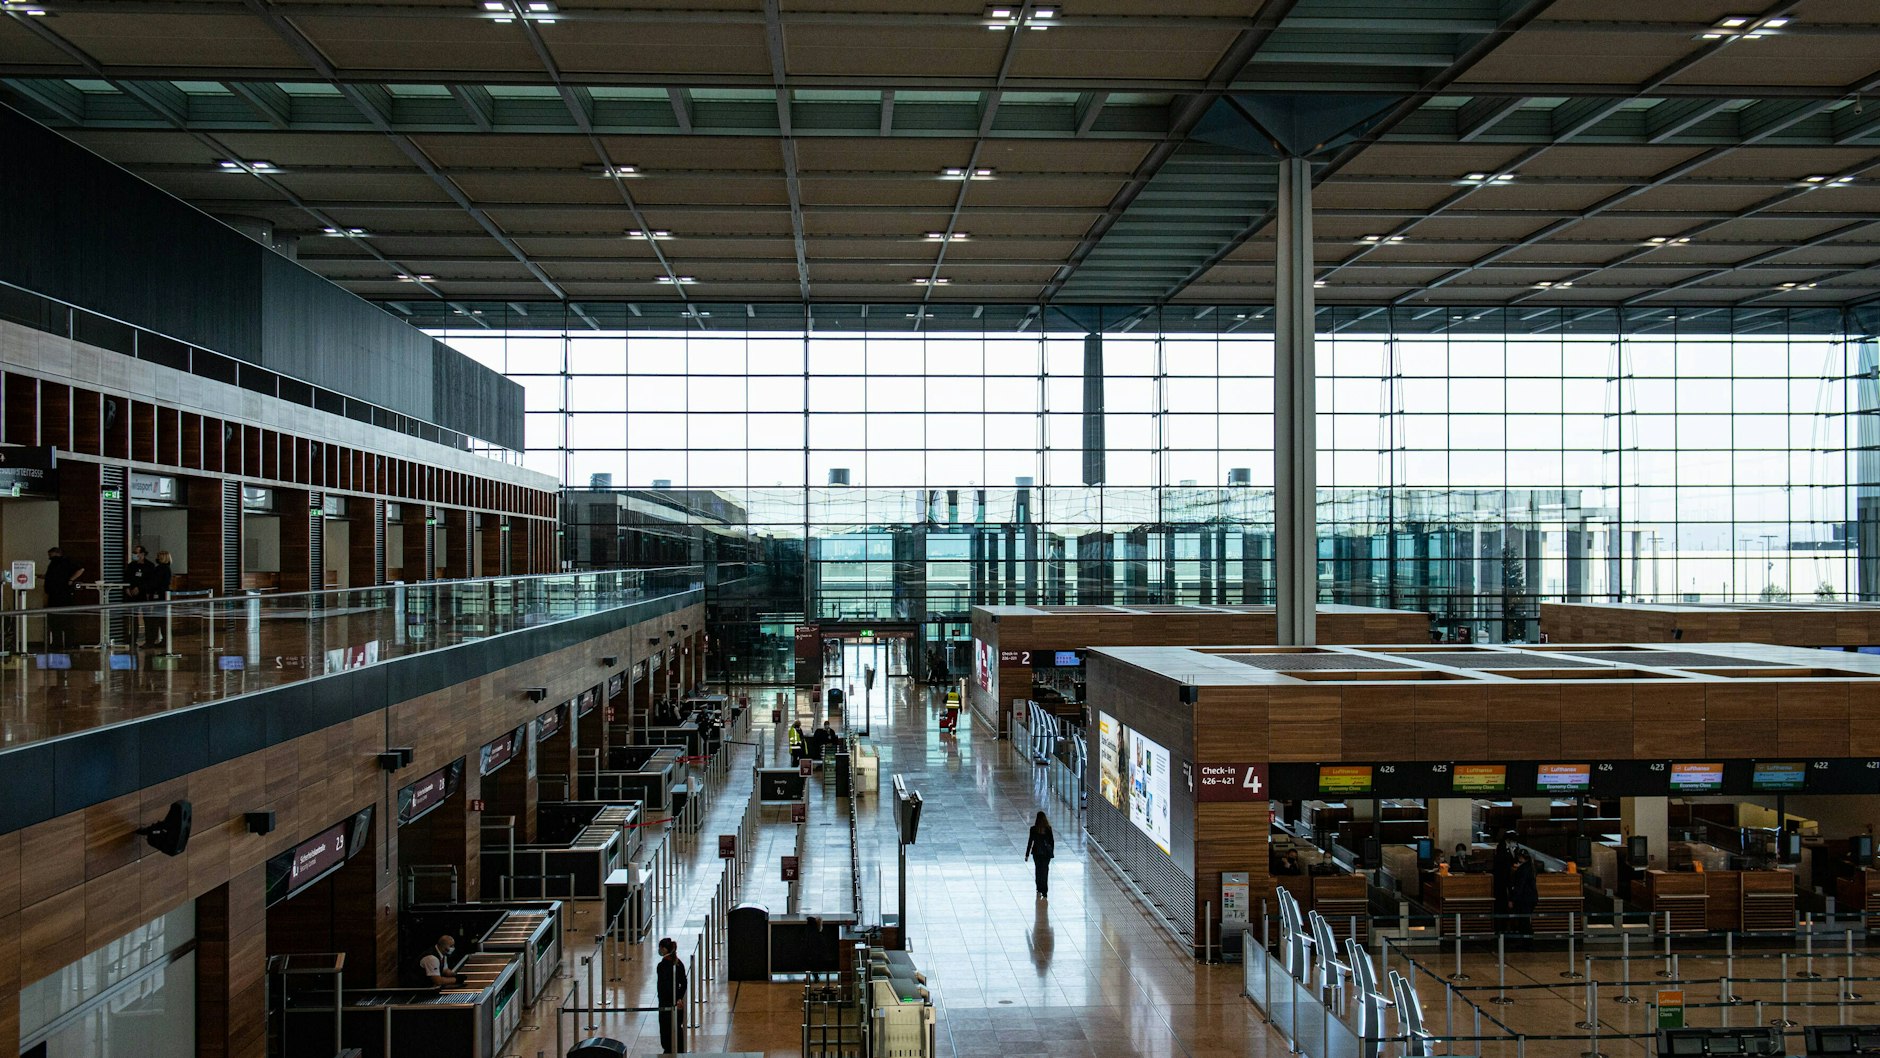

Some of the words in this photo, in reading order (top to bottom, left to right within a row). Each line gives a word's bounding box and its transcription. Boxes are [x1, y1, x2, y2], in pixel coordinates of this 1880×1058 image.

[1021, 651, 1030, 665] 2
[1380, 765, 1395, 773] 426
[1432, 764, 1447, 773] 425
[1598, 763, 1613, 771] 424
[1650, 763, 1665, 771] 423
[1813, 761, 1829, 769] 422
[1866, 761, 1880, 769] 421
[1202, 766, 1236, 775] Check-in
[1243, 766, 1262, 794] 4
